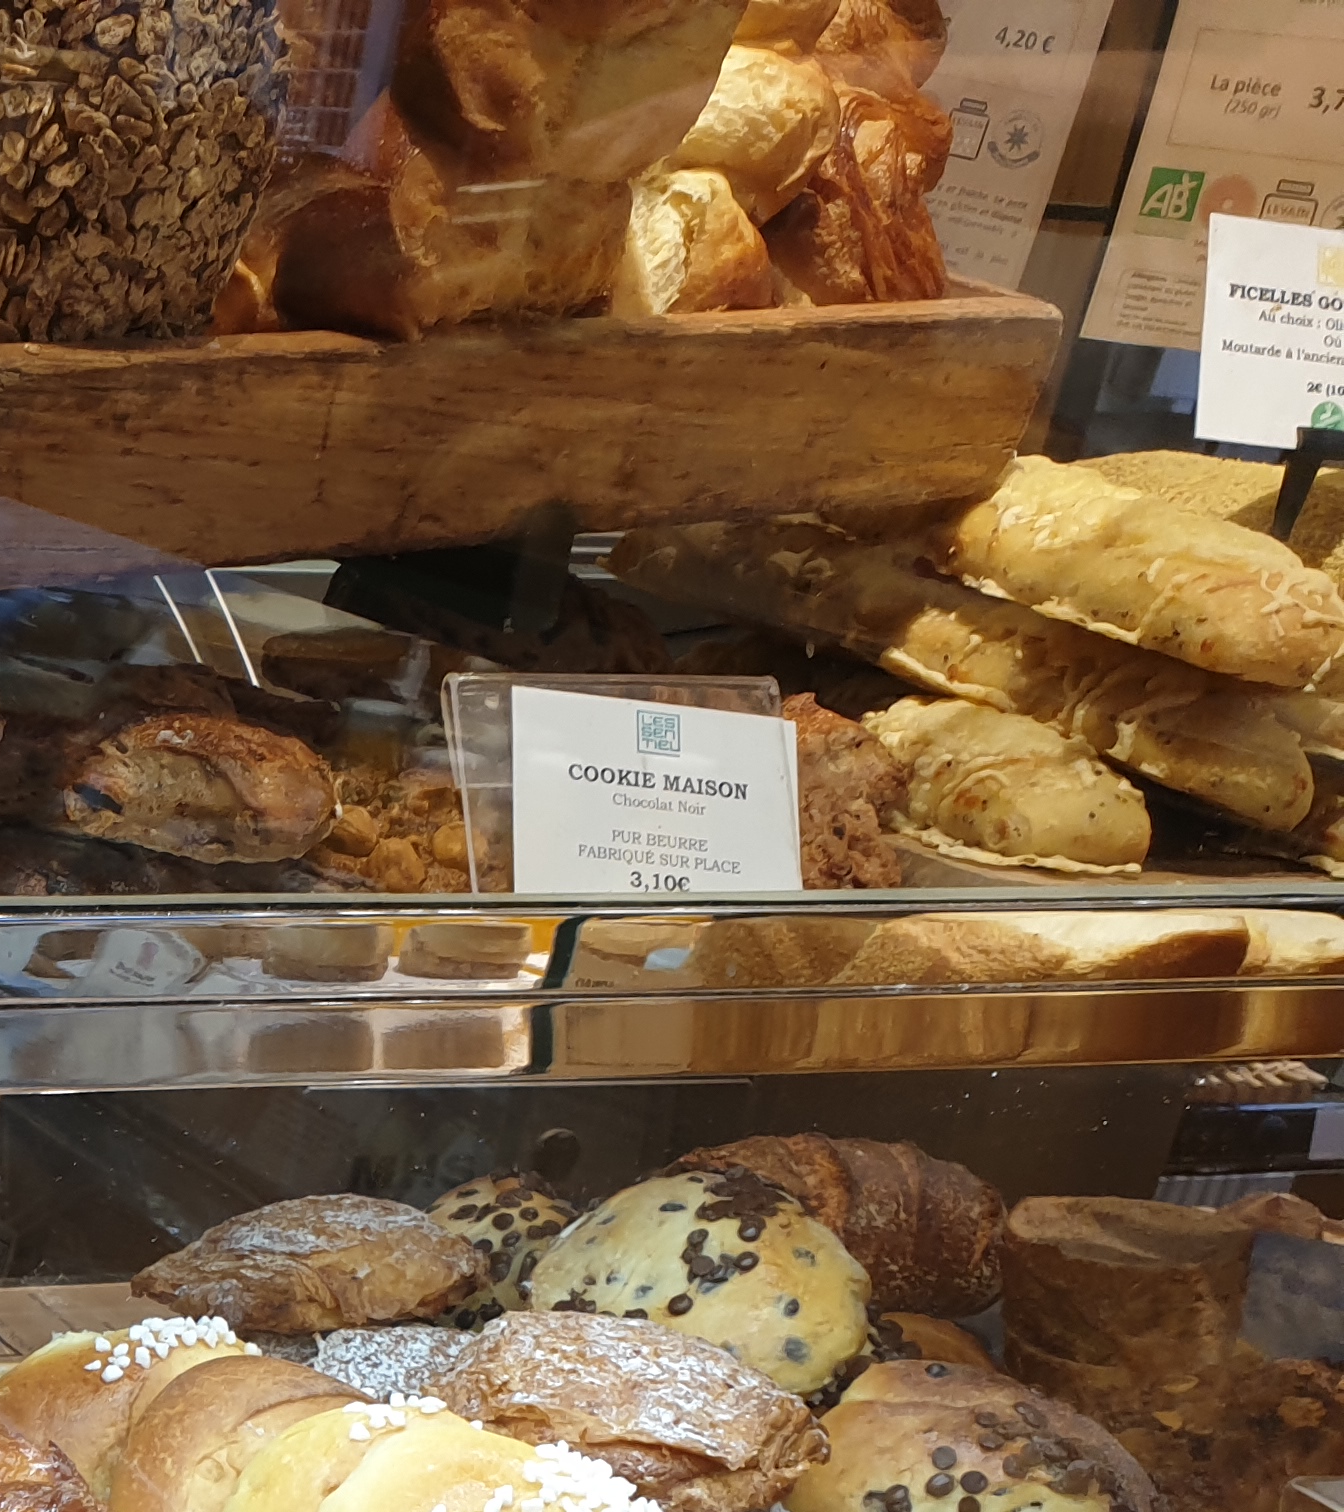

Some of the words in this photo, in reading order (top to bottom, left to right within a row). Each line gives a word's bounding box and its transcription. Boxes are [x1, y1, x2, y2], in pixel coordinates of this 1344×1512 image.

[995, 25, 1037, 52] 4,20
[1210, 74, 1230, 92] La
[1229, 283, 1313, 307] FICELLES
[1280, 312, 1314, 328] choix
[1221, 339, 1282, 357] Moutarde
[568, 763, 656, 789] COOKIE
[662, 774, 749, 801] MAISON
[612, 793, 674, 812] Chocolat
[677, 800, 707, 816] Noir
[611, 830, 642, 846] PUR
[645, 833, 709, 853] BEURRE
[629, 871, 693, 895] 3,10€
